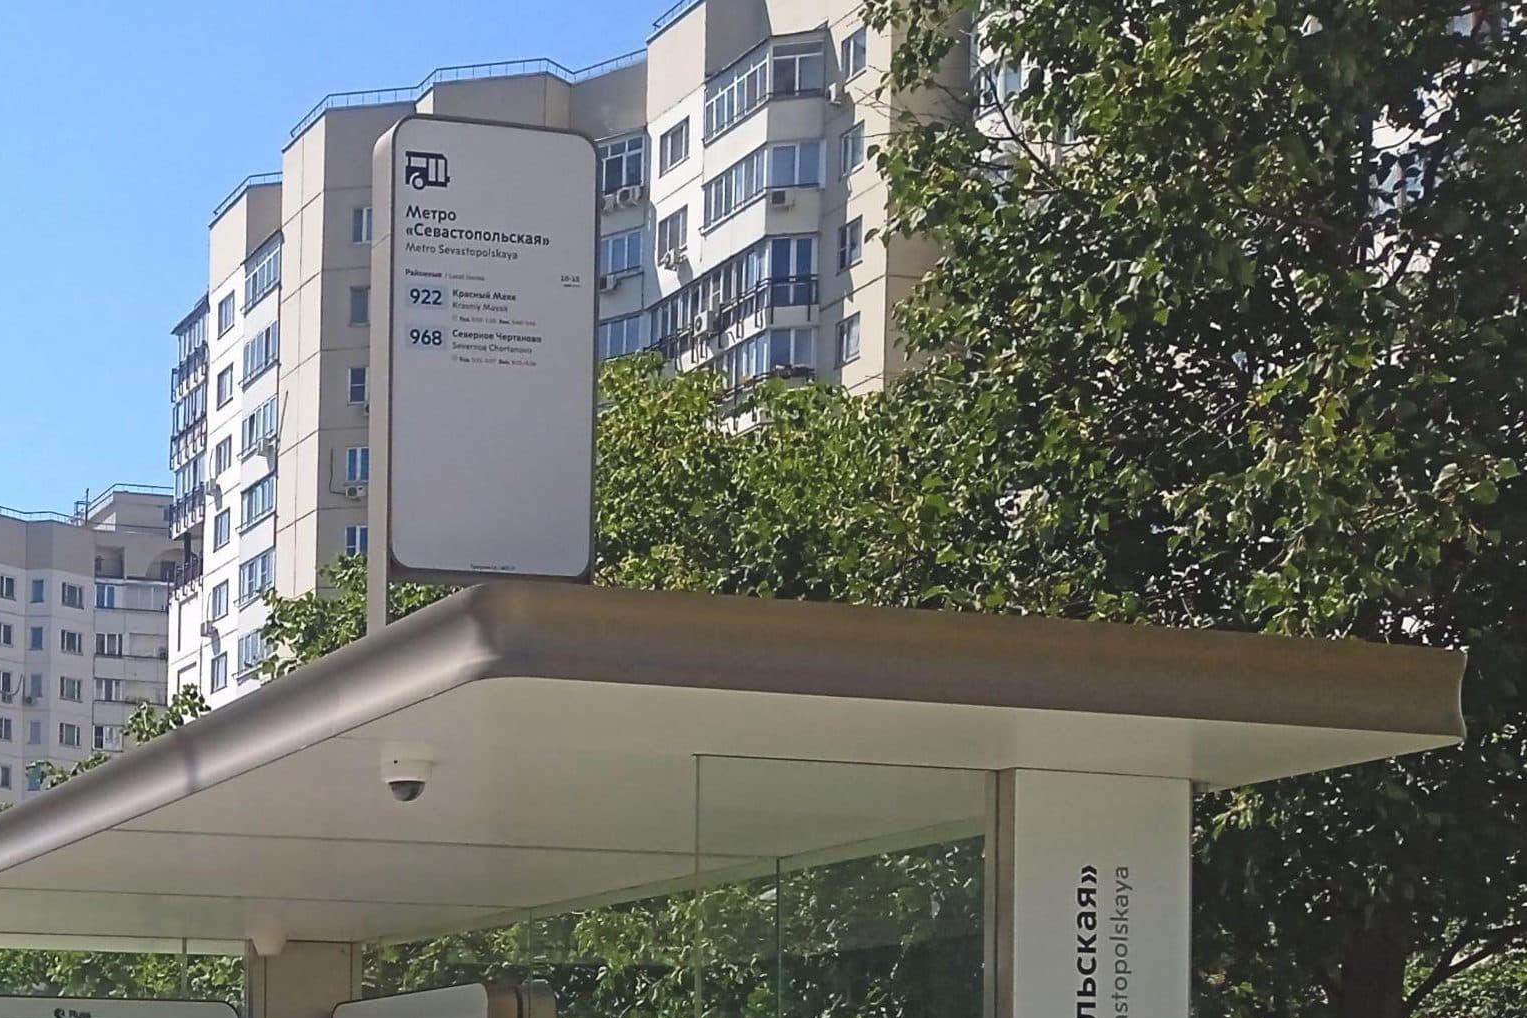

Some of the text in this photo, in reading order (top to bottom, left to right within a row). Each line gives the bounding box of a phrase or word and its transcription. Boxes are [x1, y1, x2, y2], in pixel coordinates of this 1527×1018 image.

[405, 205, 457, 223] Метро
[405, 223, 550, 246] «Севастопольская»
[405, 243, 518, 260] Metro Sevastopolskaya
[410, 288, 442, 305] 922
[452, 289, 491, 300] Красный
[410, 329, 442, 346] 968
[452, 329, 542, 343] Северное Чертаново
